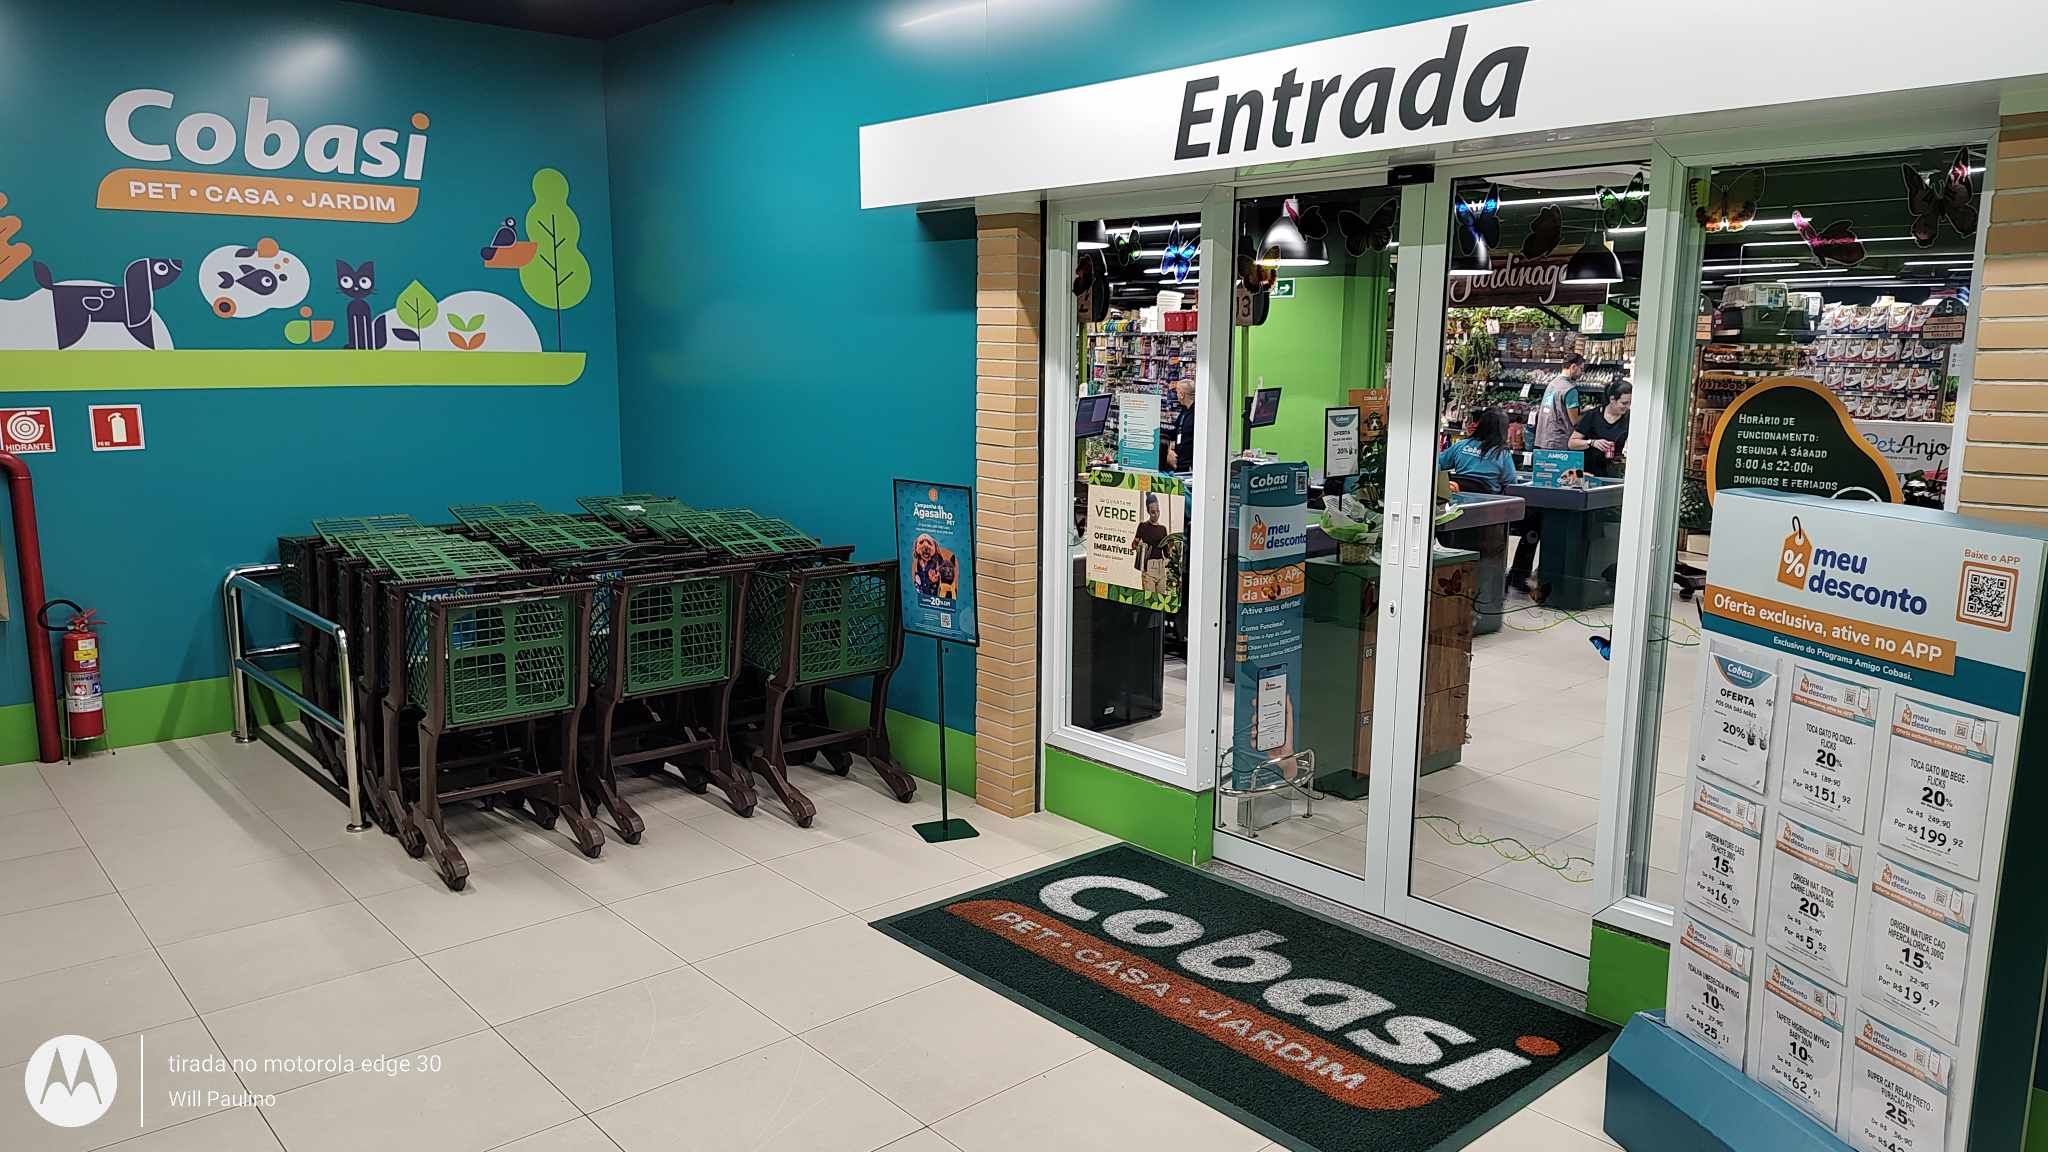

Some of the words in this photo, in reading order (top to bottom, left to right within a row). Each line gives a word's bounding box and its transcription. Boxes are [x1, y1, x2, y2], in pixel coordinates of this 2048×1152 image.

[1174, 24, 1530, 161] Entrada
[104, 88, 430, 181] Cobasi
[128, 181, 181, 201] PET
[205, 186, 280, 205] CASA
[302, 191, 396, 212] JARDIM
[1739, 413, 1780, 426] HORÁRIO
[1783, 416, 1795, 426] DE
[1737, 430, 1819, 443] FUNCIONAMENTO:
[6, 442, 51, 451] HIDRANTE
[1736, 445, 1778, 457] SEGUNDA
[1791, 446, 1827, 459] SÁBADO
[1250, 472, 1288, 488] Cobasi
[1734, 475, 1778, 487] DOMINGOS
[1783, 478, 1788, 487] E
[1791, 479, 1838, 491] FERIADOS
[913, 507, 953, 520] Agasalho
[1095, 505, 1137, 522] VERDE
[1094, 532, 1126, 543] OFERTAS
[1268, 523, 1290, 536] meu
[1266, 534, 1307, 550] desconto
[1813, 546, 1868, 575] meu
[1964, 548, 1989, 561] Baixe
[2000, 553, 2021, 565] APP
[1242, 590, 1257, 601] da
[1808, 569, 1928, 616] desconto
[1241, 607, 1262, 616] Ative
[1264, 603, 1279, 613] suas
[1713, 593, 1756, 616] Oferta
[1759, 606, 1827, 637] exclusiva,
[1832, 625, 1870, 648] ative
[1875, 636, 1896, 652] no
[1900, 639, 1943, 663] APP
[1773, 636, 1805, 652] Exclusivo
[1806, 644, 1816, 654] do
[1817, 647, 1853, 666] Programa
[1854, 657, 1881, 674] Amigo
[1882, 664, 1913, 681] Cobasi.
[1727, 663, 1753, 679] Cobasi
[1720, 688, 1755, 707] OFERTA
[1913, 714, 1929, 723] meu
[1722, 721, 1746, 739] 20%
[1806, 723, 1818, 733] TOCA
[1819, 728, 1831, 739] GATO
[1911, 721, 1947, 736] desconto
[1816, 749, 1843, 767] 20%
[1910, 758, 1925, 771] TOCA
[1925, 763, 1940, 776] GATO
[1941, 768, 1950, 778] MD
[1950, 772, 1966, 784] BEGE
[1927, 775, 1946, 789] FLICKS
[1921, 786, 1953, 808] 20%
[1894, 818, 1905, 829] Por
[1713, 856, 1734, 874] 15%
[1799, 898, 1825, 919] 20%
[1889, 918, 1910, 935] ORIGEM
[1910, 927, 1933, 944] NATURE
[1902, 947, 1932, 971] 15%
[1039, 874, 1560, 1092] Cobasi
[992, 911, 1061, 942] PET
[1075, 947, 1174, 1001] CASA
[1198, 1000, 1369, 1092] JARDIM
[1790, 1041, 1815, 1063] 10%
